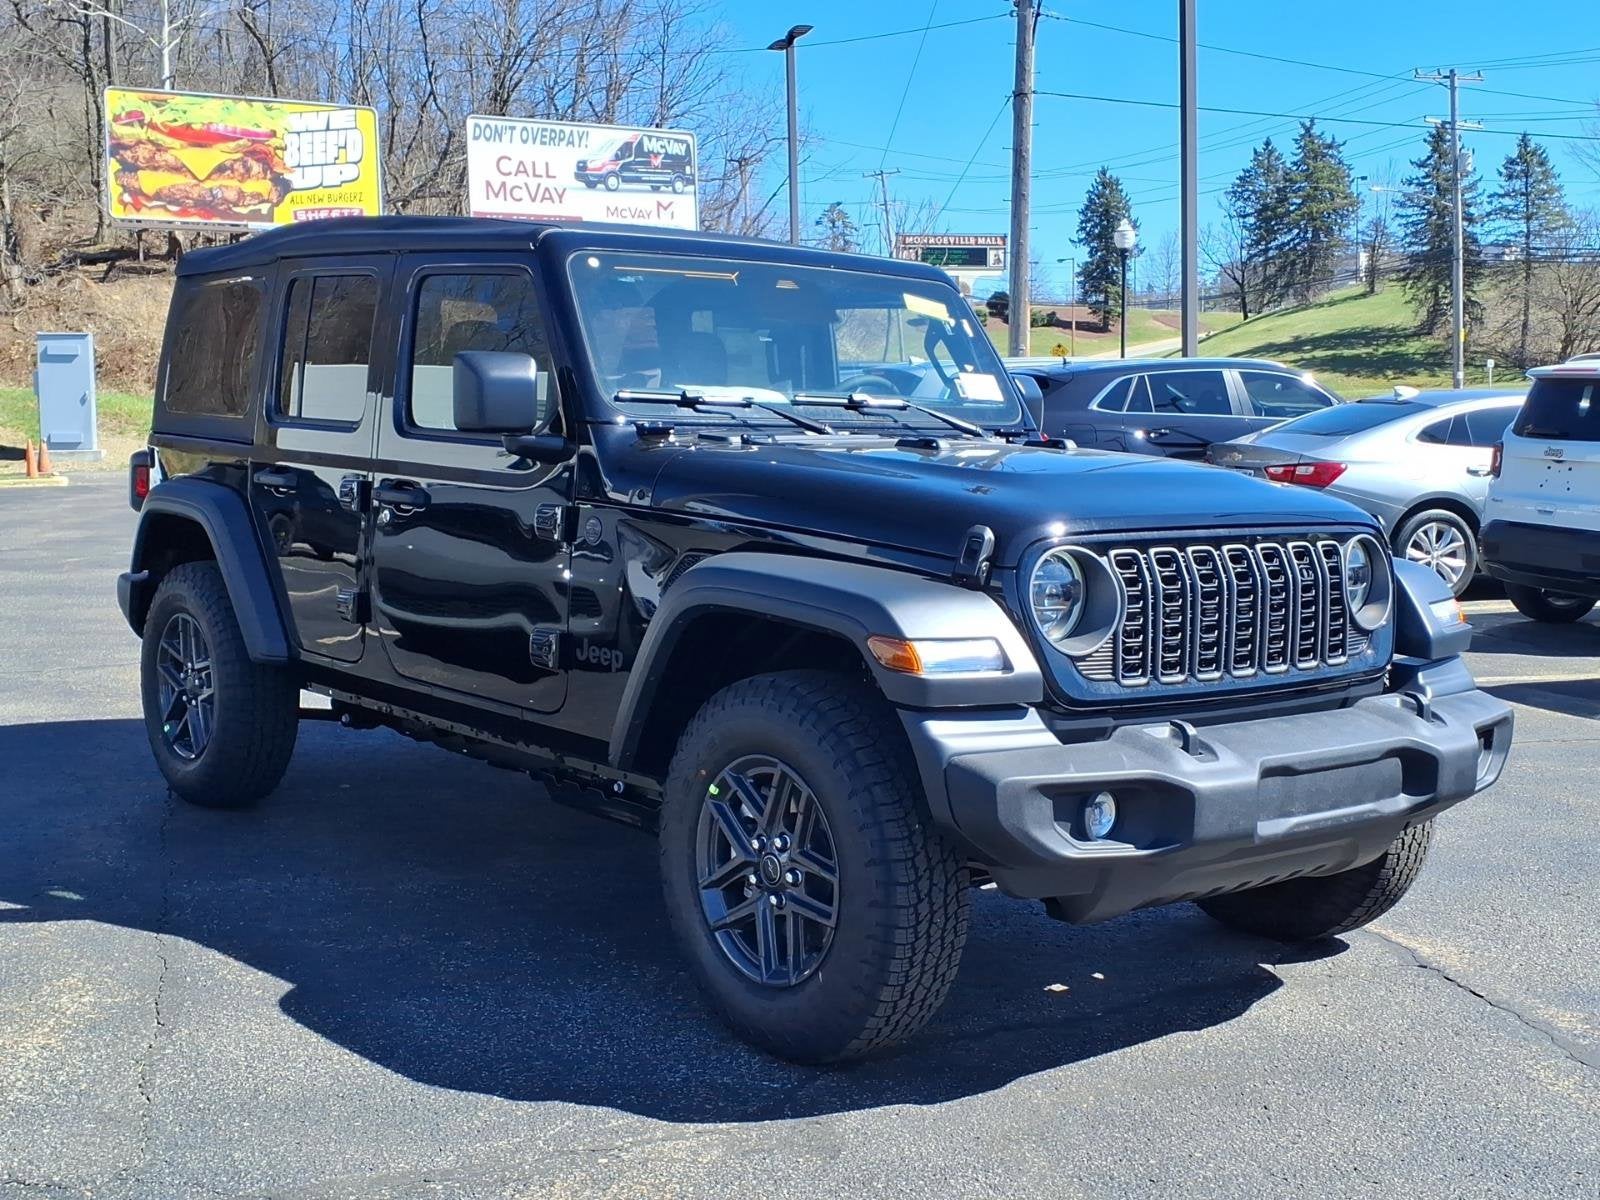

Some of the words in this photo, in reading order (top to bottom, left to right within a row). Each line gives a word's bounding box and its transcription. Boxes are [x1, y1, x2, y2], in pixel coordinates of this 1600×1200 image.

[287, 109, 356, 132] WE
[283, 128, 363, 167] BEEF'D
[472, 122, 516, 144] DON'T
[520, 126, 589, 149] OVERPAY!
[285, 163, 360, 190] UP
[496, 155, 557, 179] CALL
[290, 195, 304, 205] ALL
[307, 194, 324, 204] NEW
[327, 192, 364, 203] BURGERZ
[905, 236, 975, 246] MONROEVILLE
[977, 236, 1004, 246] MALL
[1544, 446, 1563, 458] Jeep
[576, 637, 624, 673] Jeep
